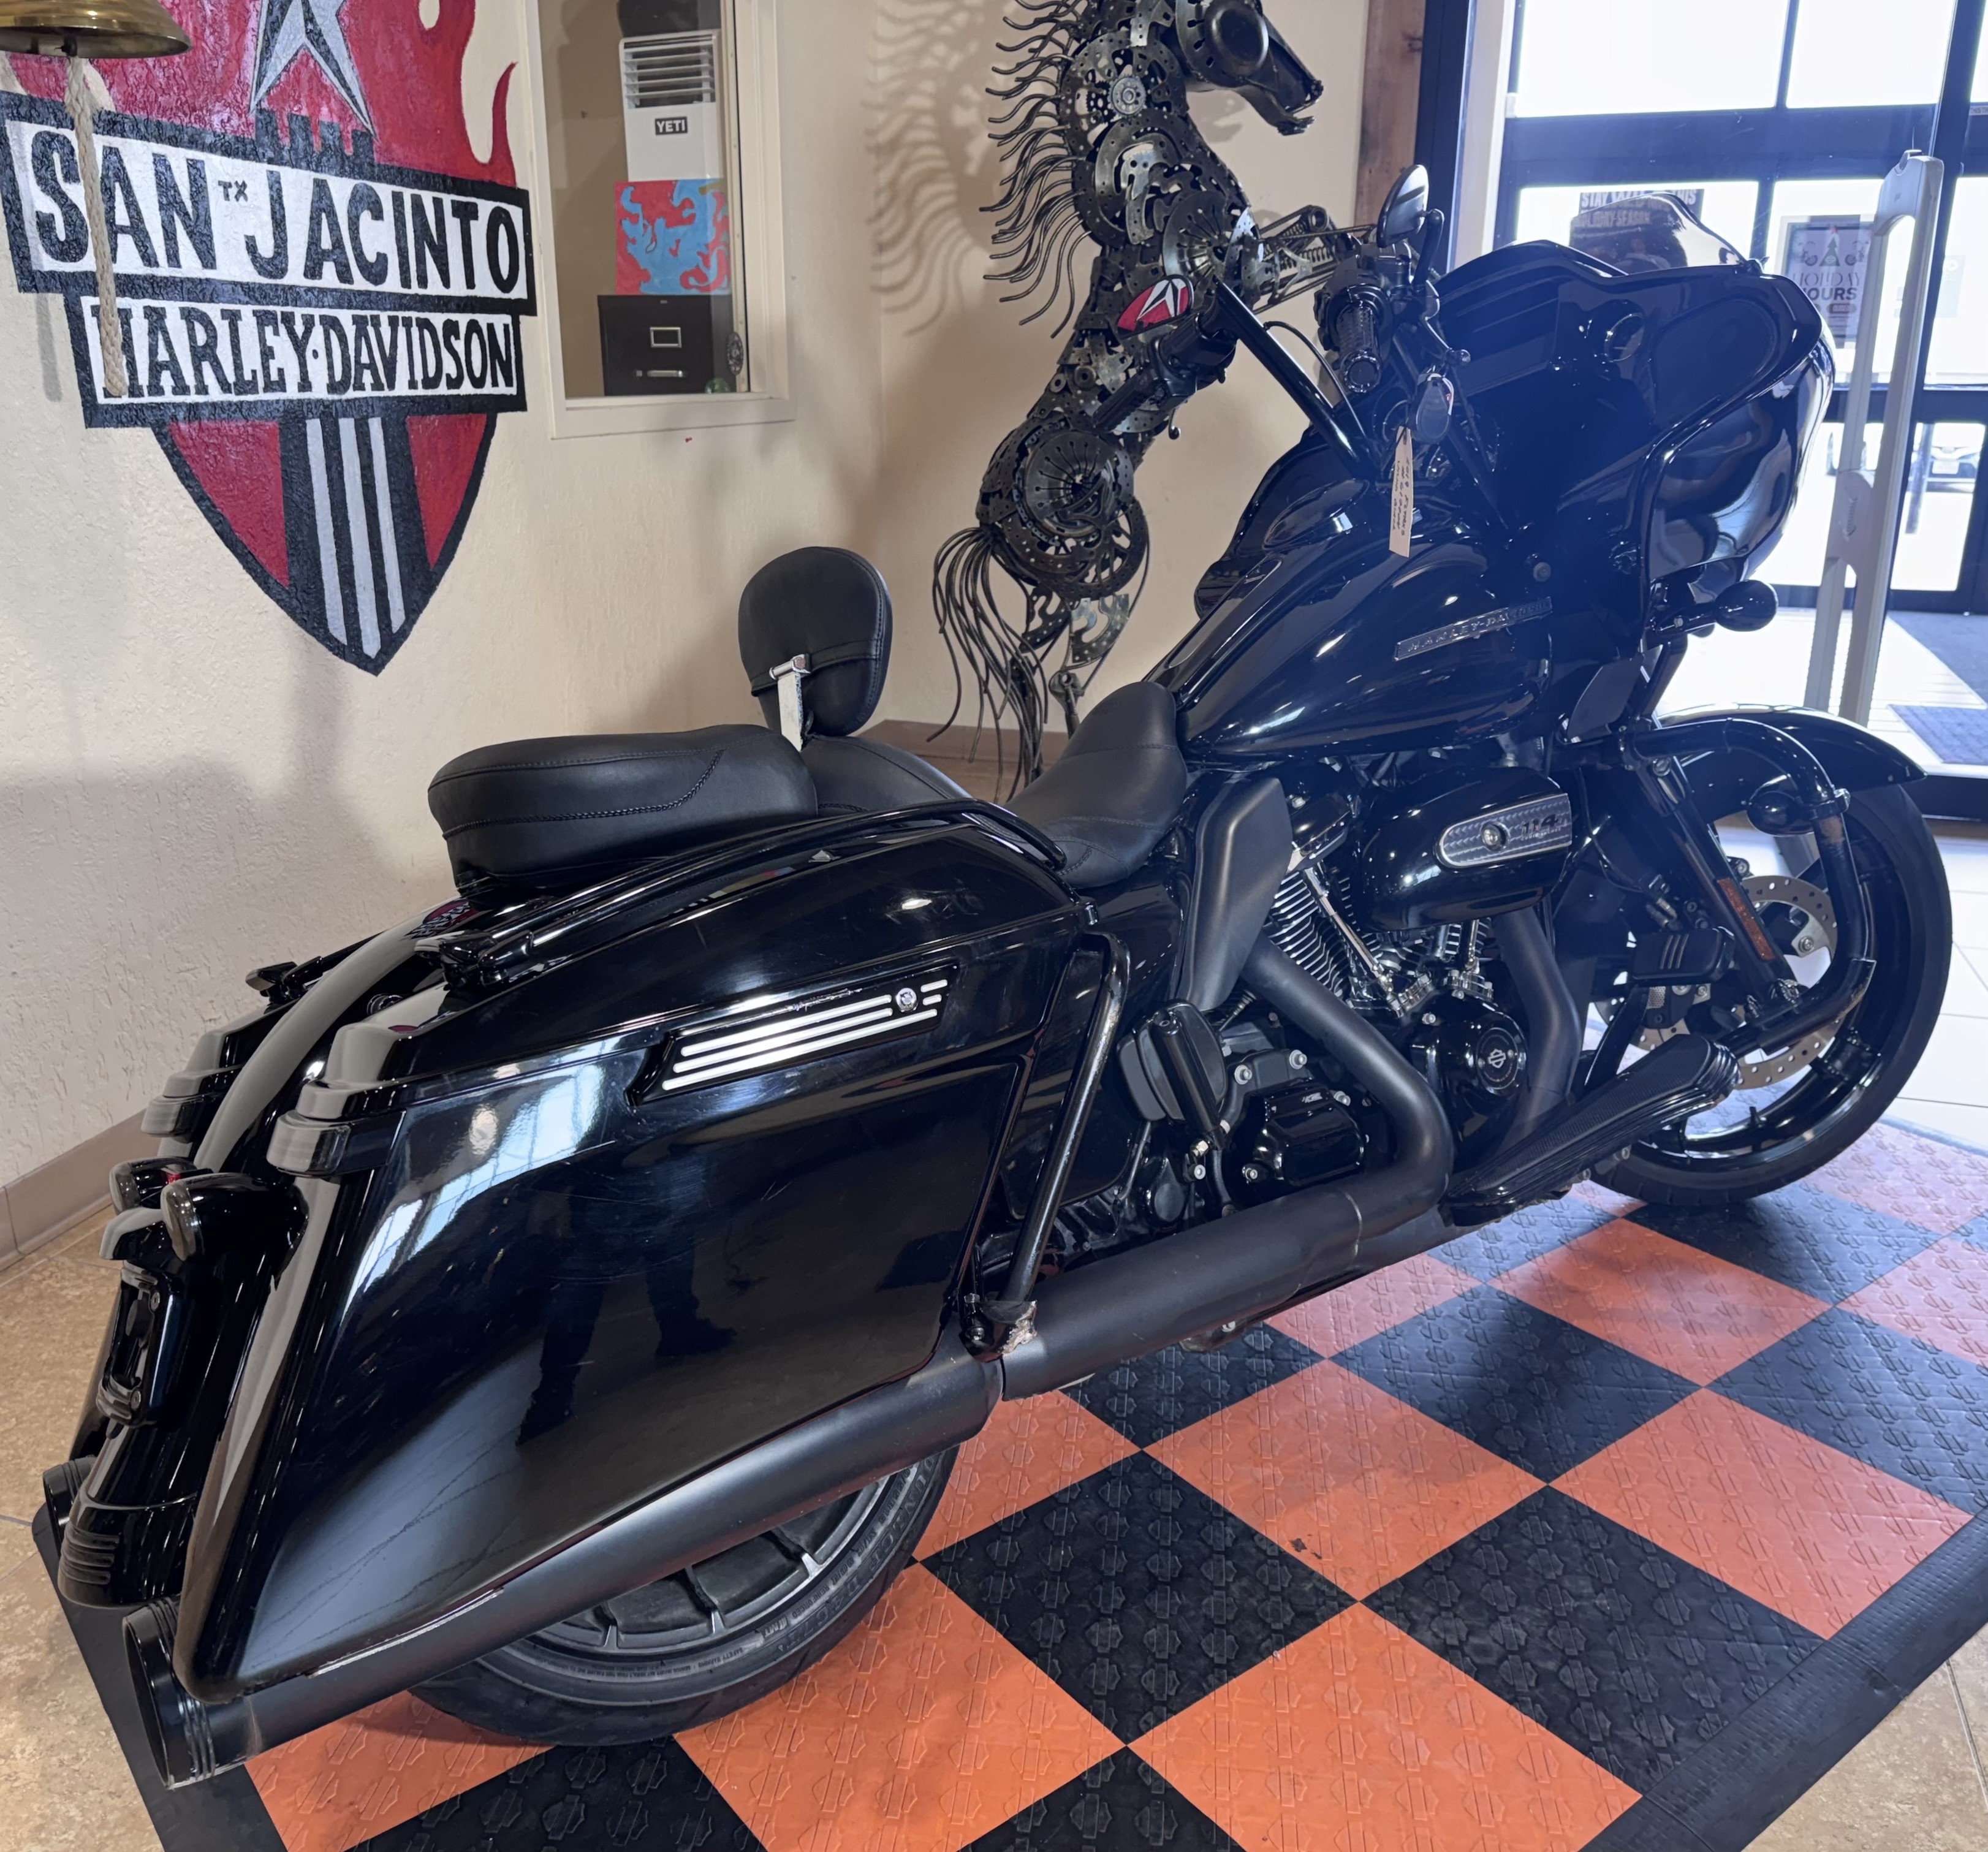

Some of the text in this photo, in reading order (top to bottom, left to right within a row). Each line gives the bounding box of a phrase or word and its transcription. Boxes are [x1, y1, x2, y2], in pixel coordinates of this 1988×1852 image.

[656, 120, 685, 132] YETI
[218, 180, 248, 202] TX
[1581, 192, 1608, 208] STAY
[31, 130, 520, 293] SAN JACINTO
[1802, 287, 1857, 301] OURS
[1522, 814, 1559, 835] 114
[791, 1585, 830, 1618] REINFORCED
